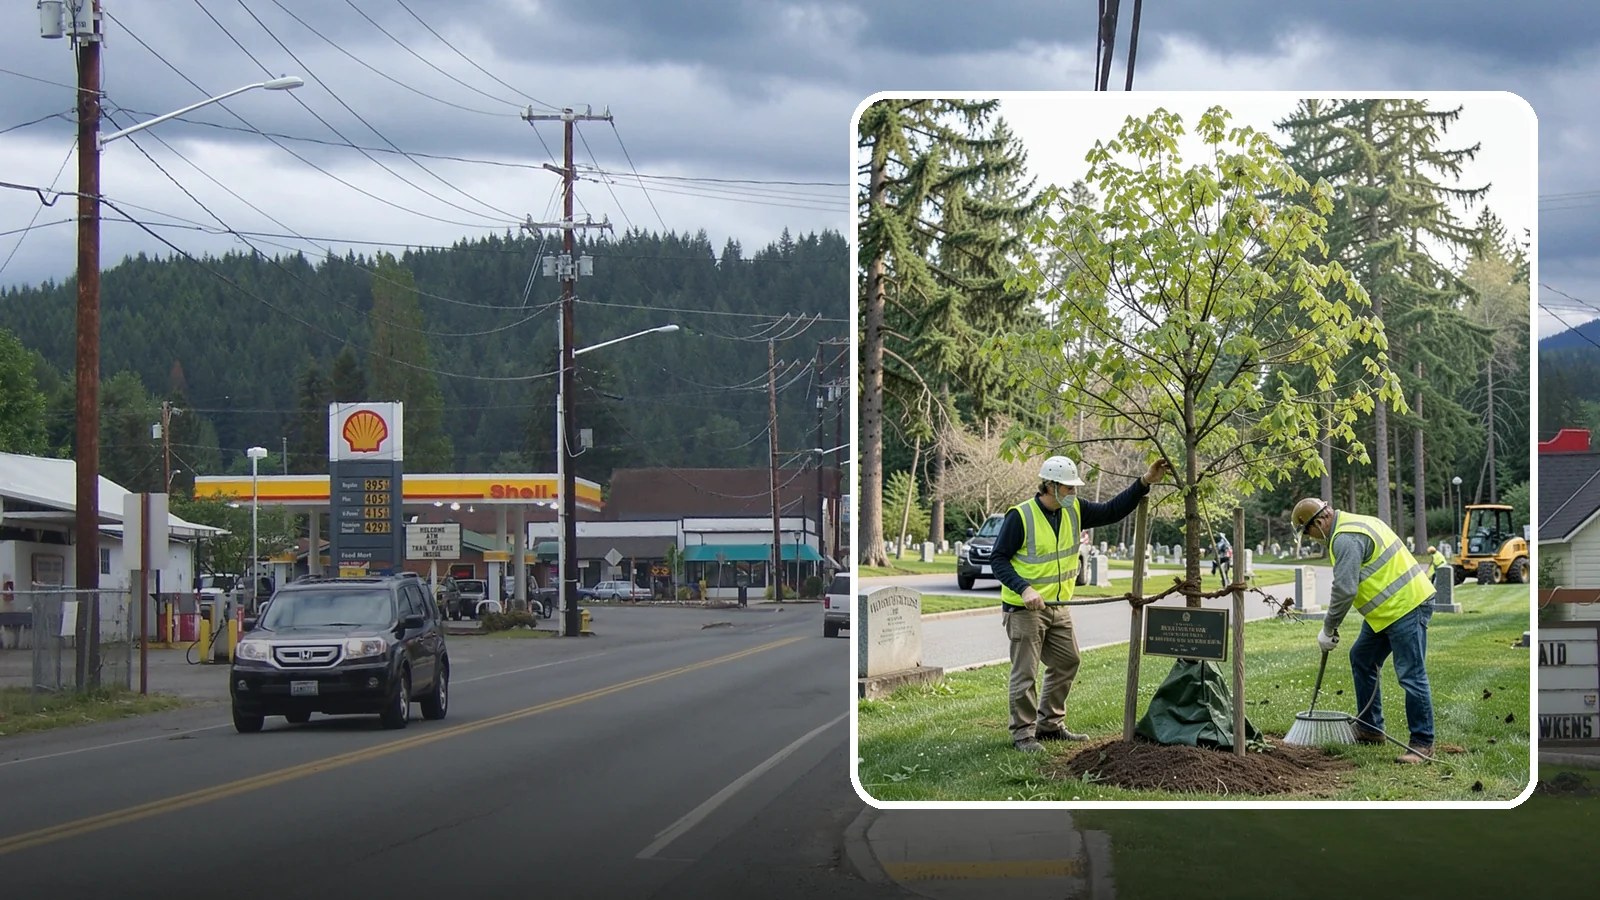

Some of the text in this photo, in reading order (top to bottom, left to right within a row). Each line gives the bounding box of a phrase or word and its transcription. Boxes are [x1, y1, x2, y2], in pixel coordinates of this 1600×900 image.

[366, 480, 384, 490] 395
[490, 484, 547, 499] Shell
[366, 494, 384, 504] 405
[366, 508, 384, 518] 415
[366, 522, 384, 533] 429
